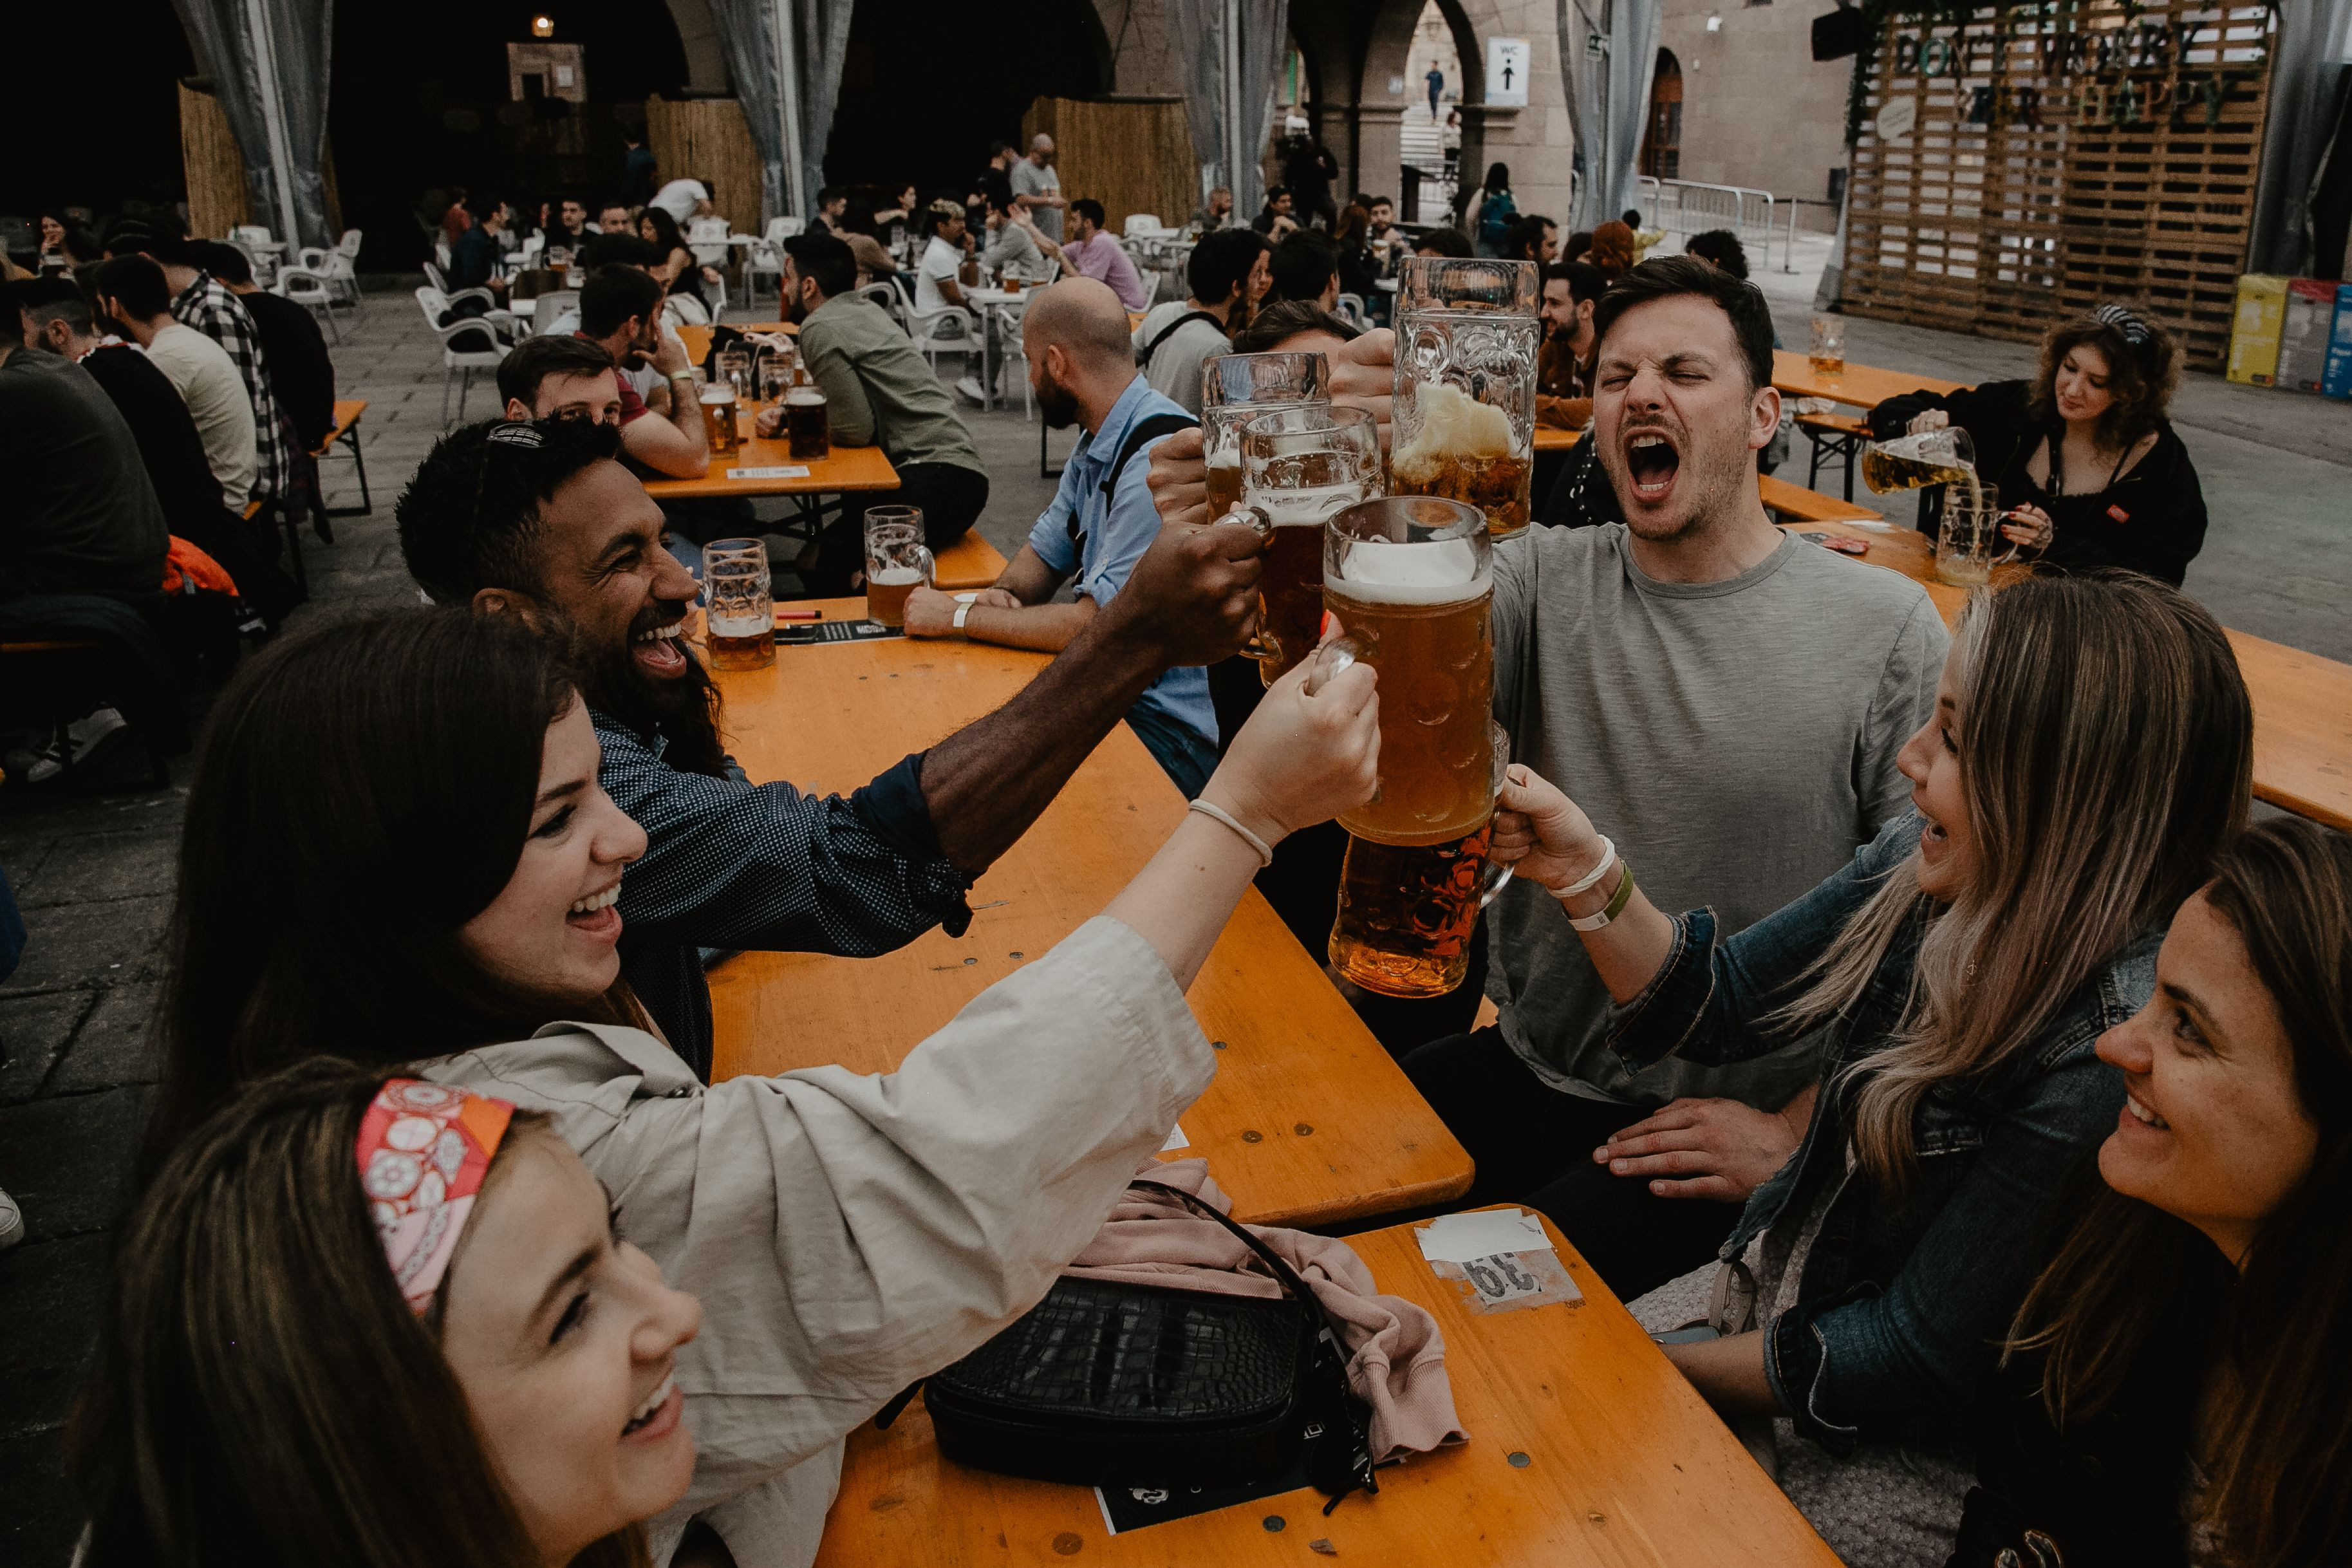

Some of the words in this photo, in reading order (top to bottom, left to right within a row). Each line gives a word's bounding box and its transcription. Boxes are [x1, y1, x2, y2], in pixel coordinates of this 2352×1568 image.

[1500, 46, 1518, 55] WC
[2042, 21, 2208, 75] WORRY
[2074, 77, 2235, 127] HAPPY
